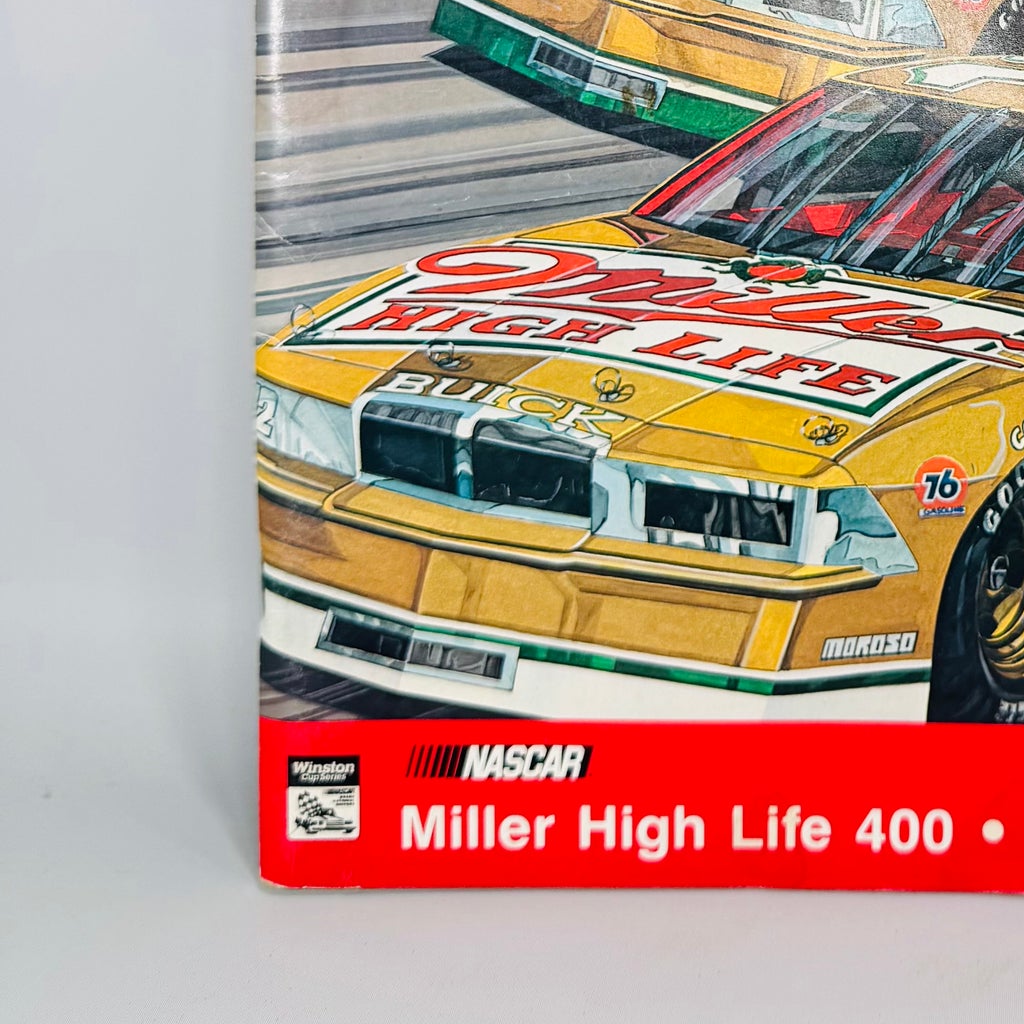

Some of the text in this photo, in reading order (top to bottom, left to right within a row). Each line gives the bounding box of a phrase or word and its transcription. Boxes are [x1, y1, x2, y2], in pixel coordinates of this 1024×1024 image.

[353, 300, 901, 397] HIGH LIFE
[378, 372, 632, 440] BUICK
[922, 467, 962, 503] 76
[820, 631, 918, 661] MOROSO
[291, 760, 355, 775] Winston
[461, 743, 586, 781] NASCAR
[401, 804, 556, 851] Miller
[579, 804, 705, 861] High
[732, 805, 832, 852] Life
[855, 808, 953, 854] 400
